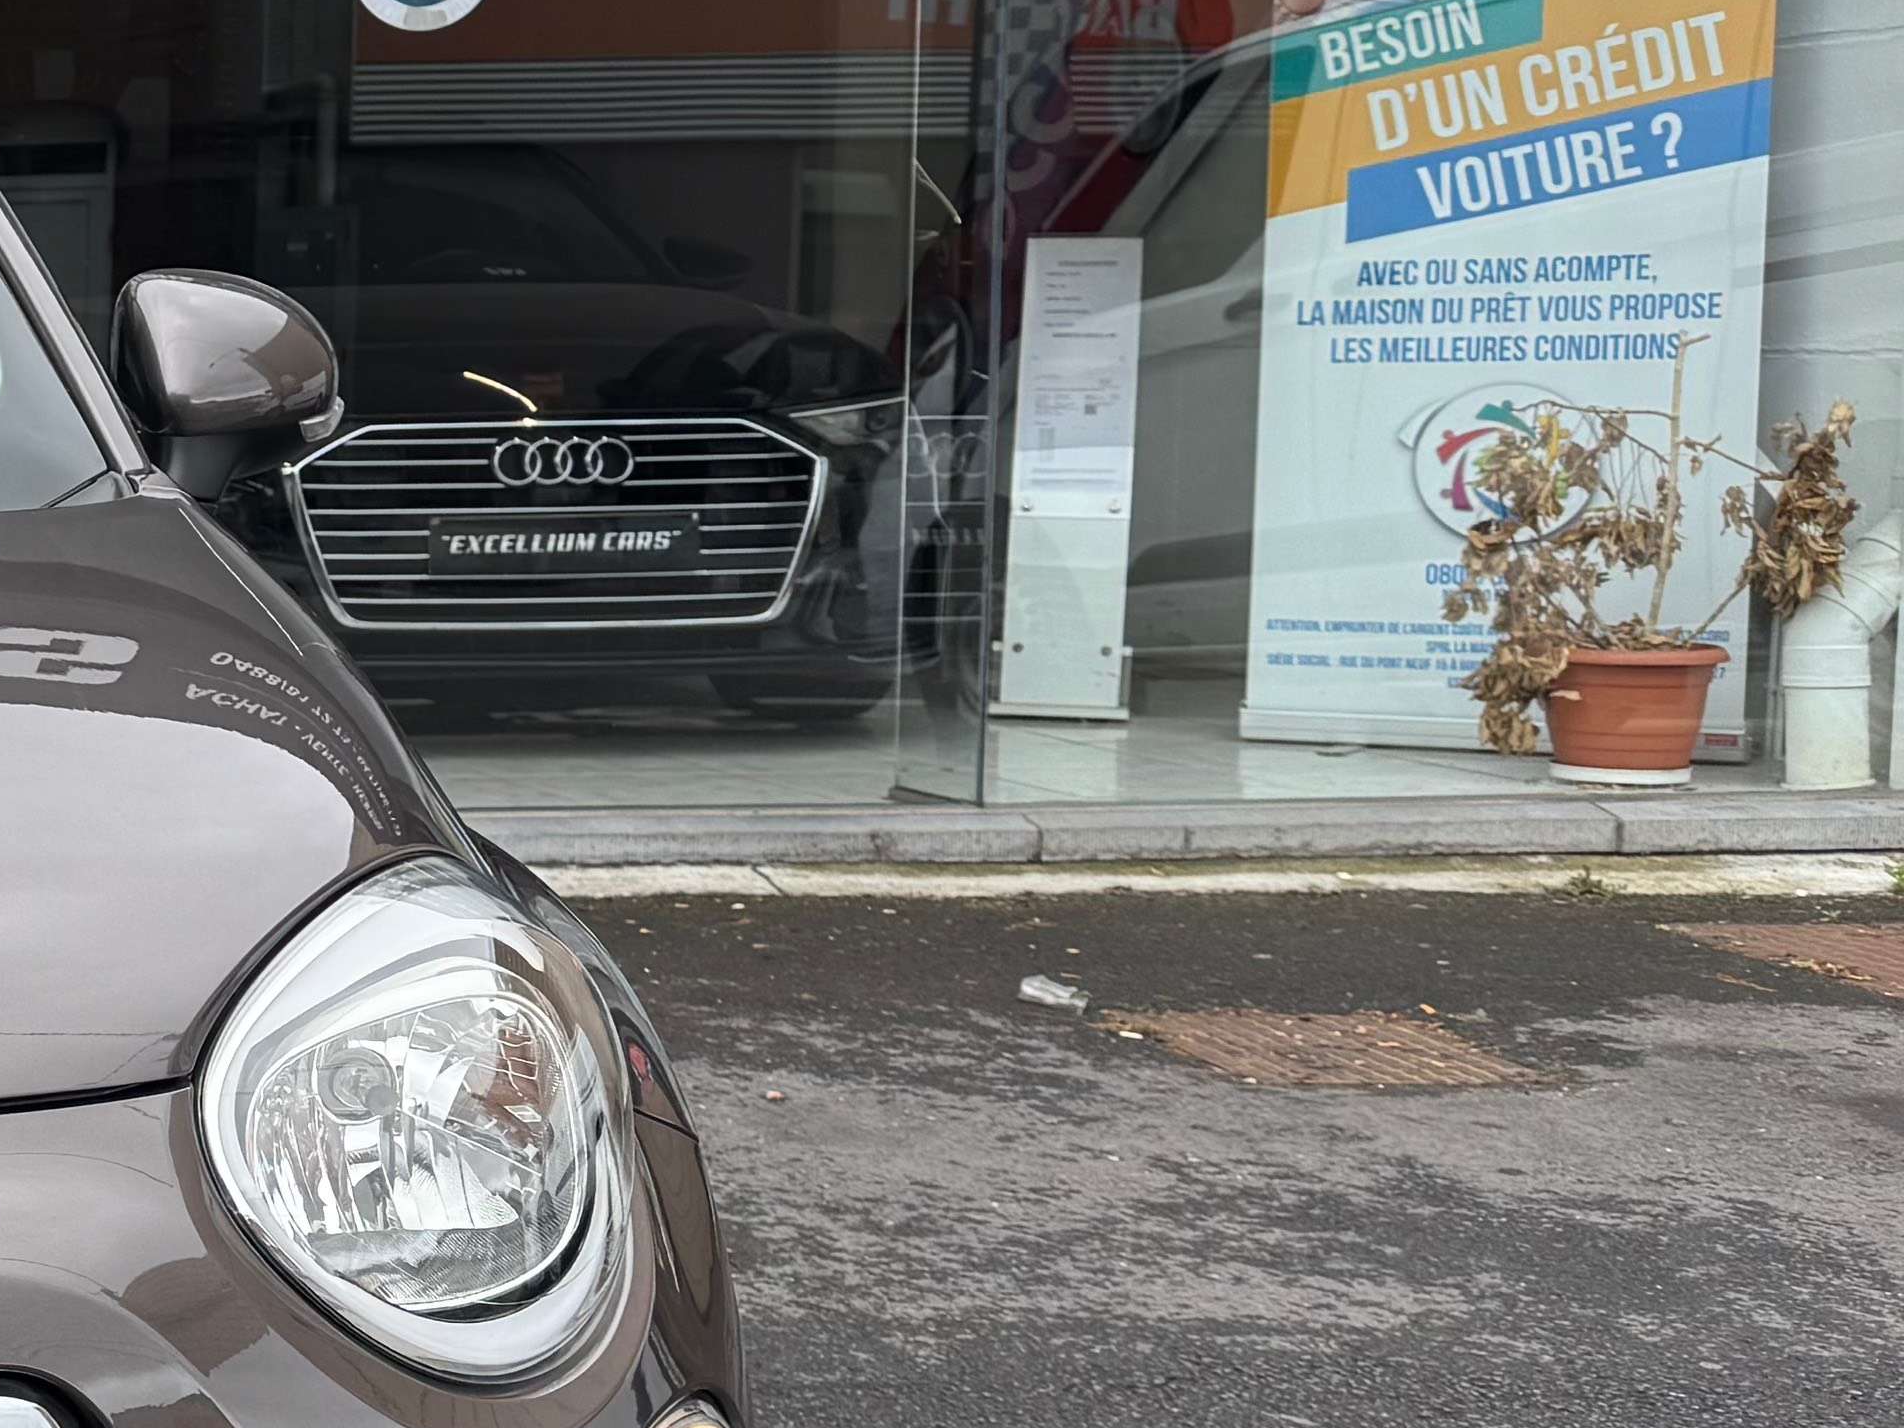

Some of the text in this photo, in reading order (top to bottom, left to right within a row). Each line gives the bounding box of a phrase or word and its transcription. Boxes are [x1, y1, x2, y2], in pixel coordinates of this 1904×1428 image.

[1517, 11, 1727, 118] CRÉDIT
[1417, 111, 1684, 220] VOITURE ?
[1357, 254, 1658, 286] AVEC OU SANS ACOMPTE,
[1297, 290, 1723, 326] LA MAISON DU PRÊT VOUS PROPOSE
[1330, 338, 1373, 364] LES
[1378, 335, 1528, 363] MEILLEURES
[449, 531, 672, 554] EXCELLIUM CARS
